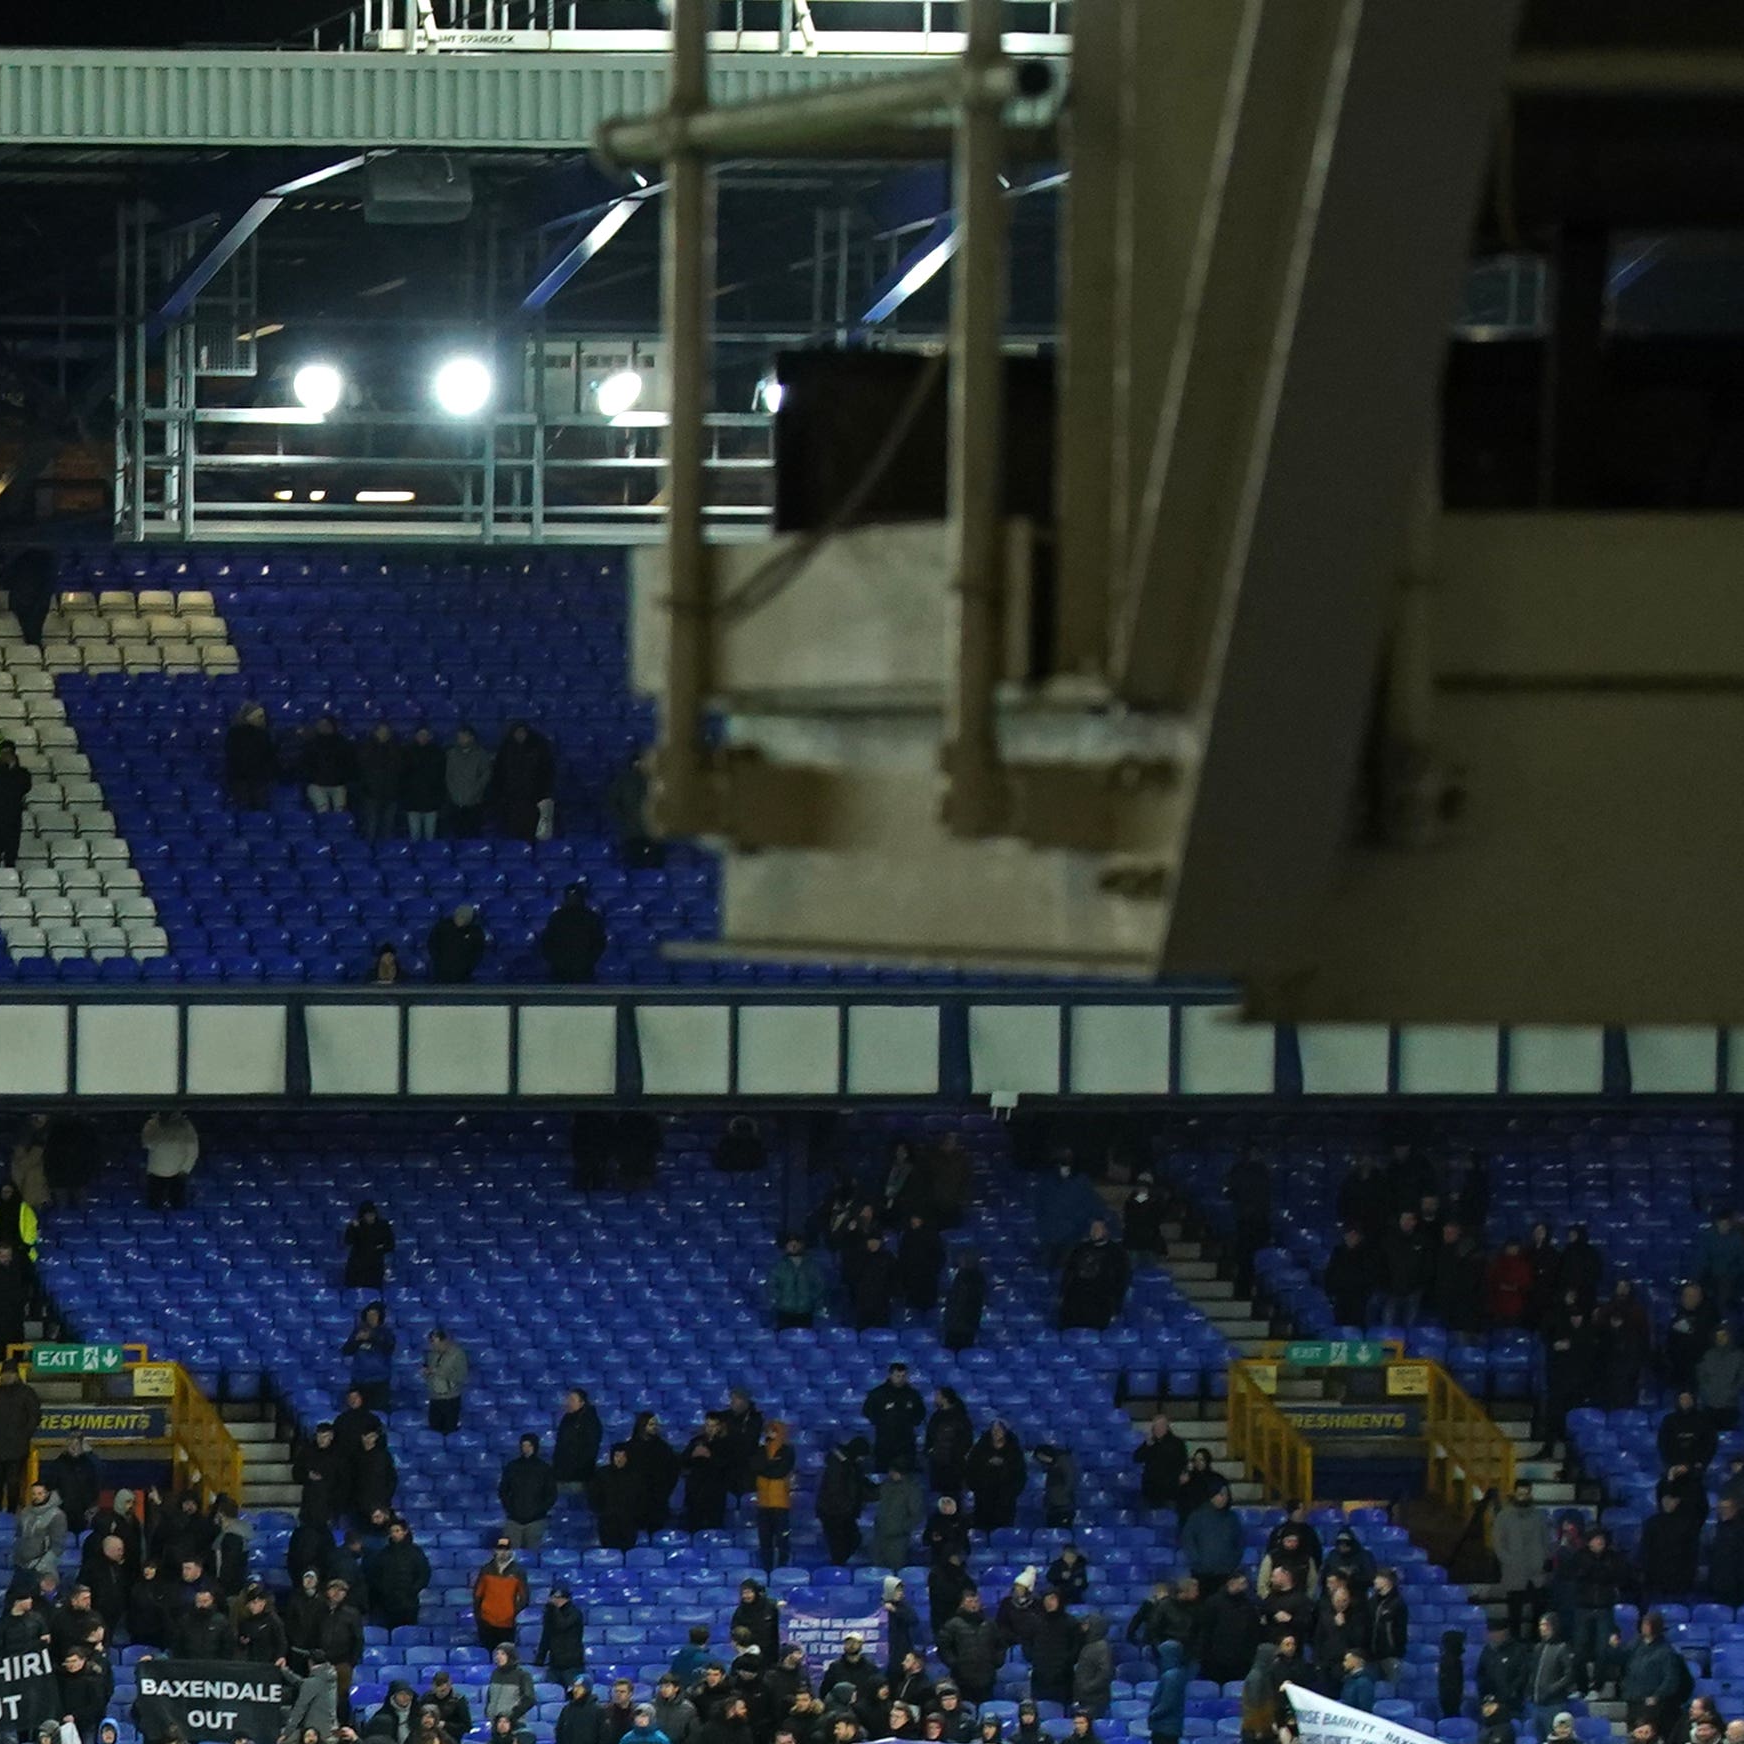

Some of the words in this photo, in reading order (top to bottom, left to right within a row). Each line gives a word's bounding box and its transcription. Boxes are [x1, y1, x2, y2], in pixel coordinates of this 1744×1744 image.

[36, 1350, 79, 1367] EXIT
[39, 1414, 151, 1430] RESHMENTS
[1290, 1413, 1406, 1429] RESHMENTS
[141, 1678, 282, 1703] BAXENDALE
[188, 1709, 238, 1731] OUT
